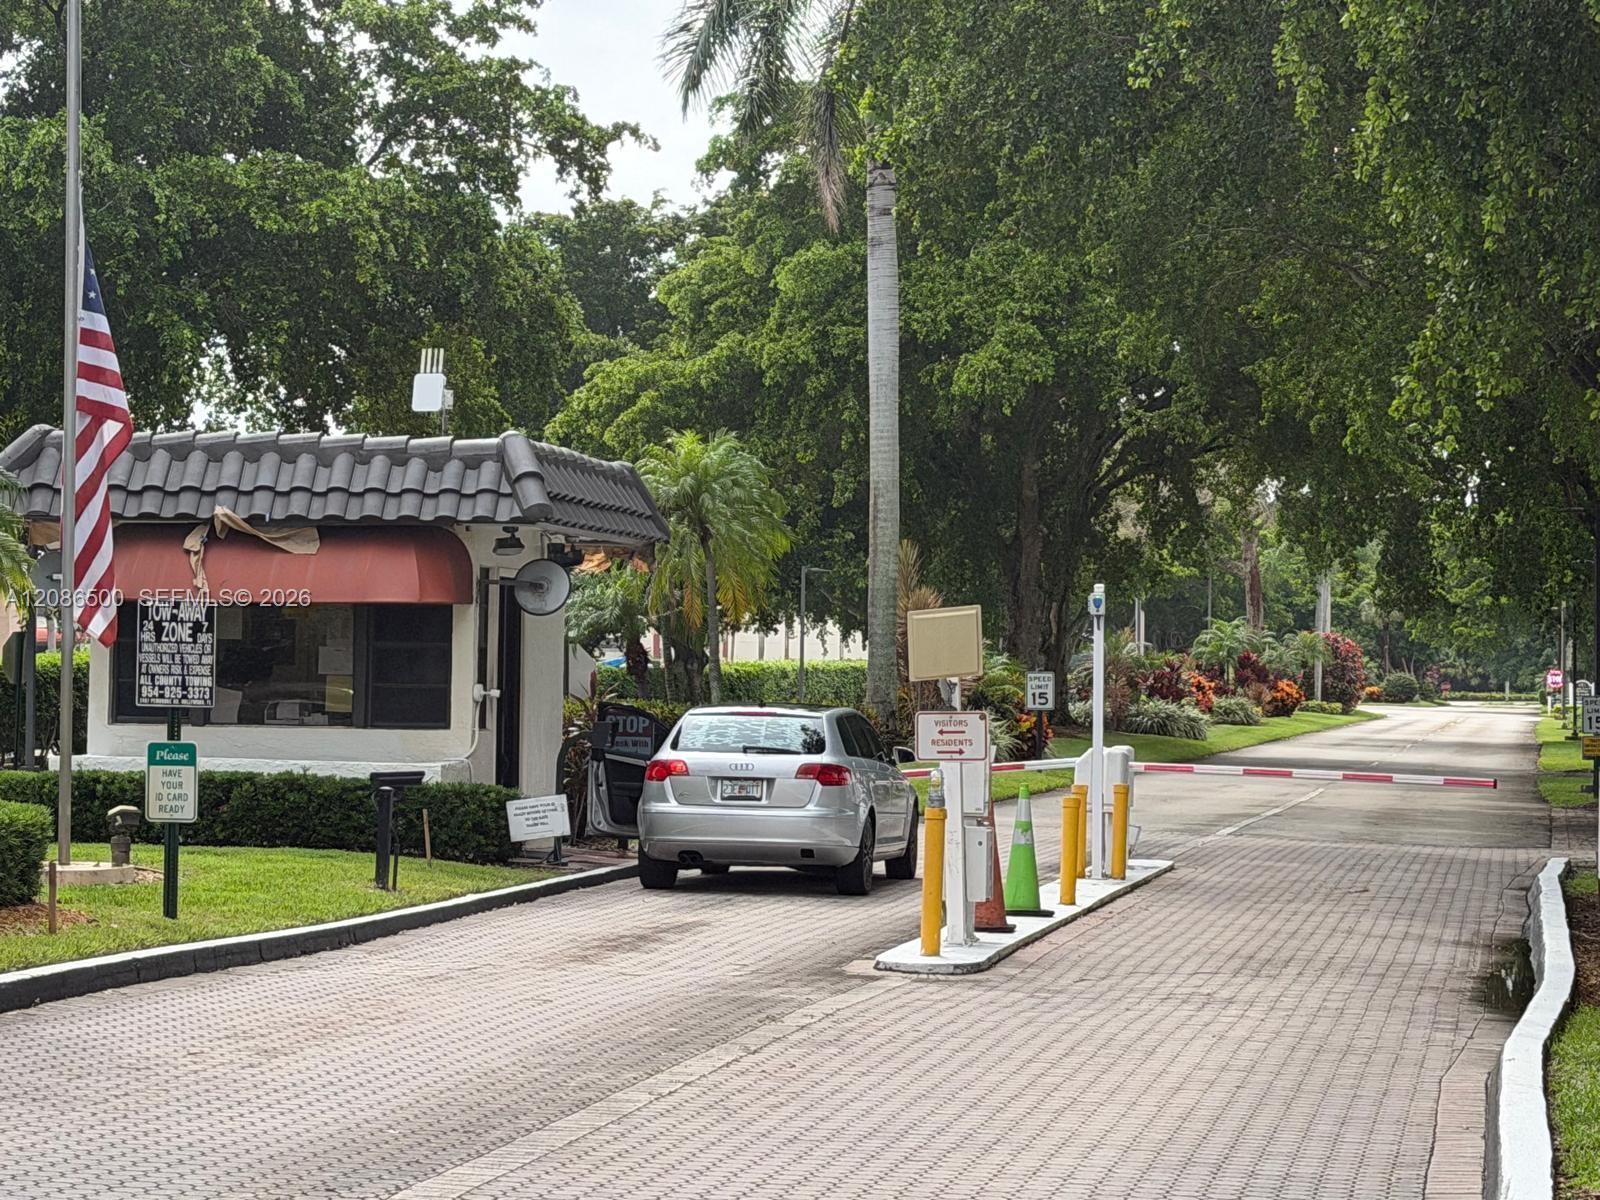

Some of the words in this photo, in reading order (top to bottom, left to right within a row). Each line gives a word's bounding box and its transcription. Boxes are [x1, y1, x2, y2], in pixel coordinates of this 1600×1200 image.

[146, 601, 208, 621] TOW-AWAY
[142, 620, 154, 631] 24
[201, 622, 209, 632] 7
[161, 621, 193, 642] ZONE
[140, 632, 156, 642] HRS
[197, 633, 212, 643] DAYS
[141, 643, 178, 653] UNAUTHORIZED
[179, 643, 202, 654] VEHICLES
[162, 653, 173, 664] WILL
[174, 654, 181, 664] BE
[140, 675, 152, 685] ALL
[155, 675, 182, 686] COUNTY
[185, 676, 212, 687] TOWING
[141, 686, 210, 699] 954-925-3373
[1031, 692, 1049, 706] 15
[934, 719, 969, 728] VISITORS
[930, 738, 974, 747] RESIDENTS
[155, 748, 190, 760] Please
[161, 769, 183, 778] HAVE
[160, 781, 184, 790] YOUR
[155, 793, 163, 801] ID
[166, 793, 189, 801] CARD
[158, 804, 185, 813] READY
